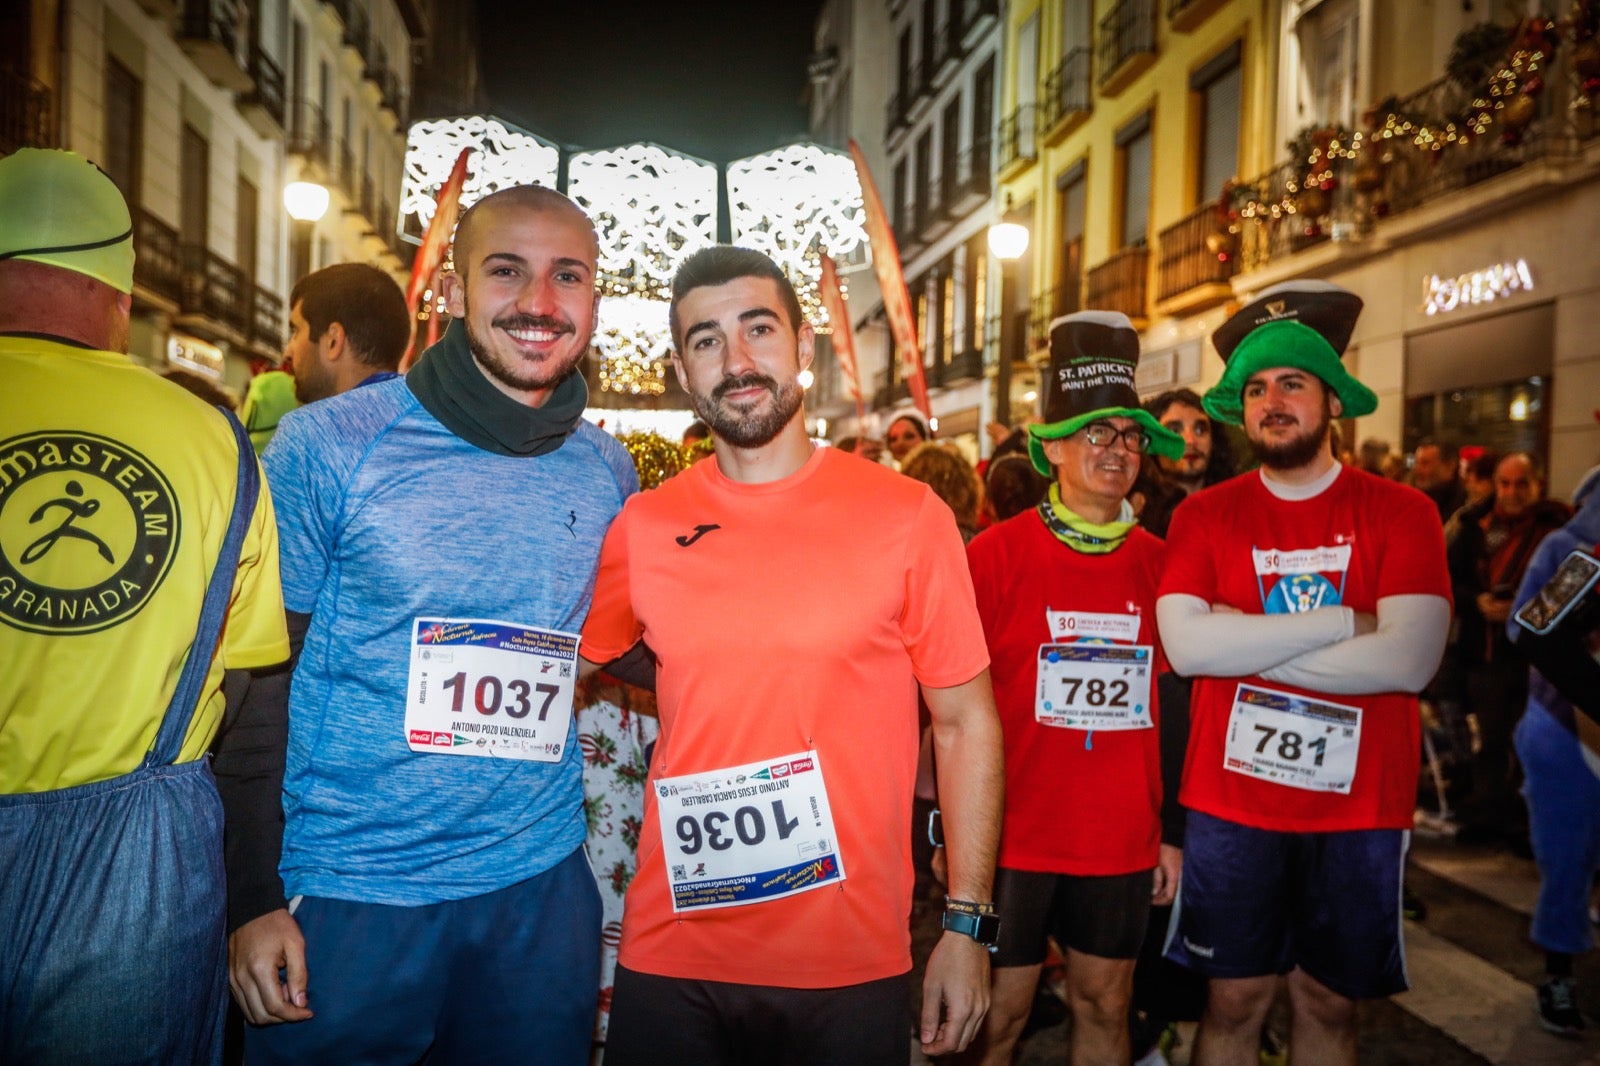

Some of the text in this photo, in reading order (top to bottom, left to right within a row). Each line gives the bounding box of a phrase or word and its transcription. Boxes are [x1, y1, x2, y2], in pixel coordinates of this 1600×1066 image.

[1059, 362, 1134, 380] ST. PATRICK'S
[0, 441, 168, 536] masTEAM
[0, 576, 141, 620] GRANADA
[431, 628, 475, 644] Nocturna
[1059, 617, 1076, 631] 30
[500, 640, 574, 659] #NocturnaGranada2022
[442, 671, 560, 722] 1037
[1061, 678, 1129, 707] 782
[451, 721, 536, 738] ANTONIO POZO VALENZUELA
[1254, 724, 1327, 766] 781
[681, 779, 790, 807] ANTONIO JESUS GARCIA CABALLERO
[676, 799, 799, 855] 1036
[674, 876, 756, 893] #NocturnaGranada2022
[784, 859, 823, 885] Nocturna
